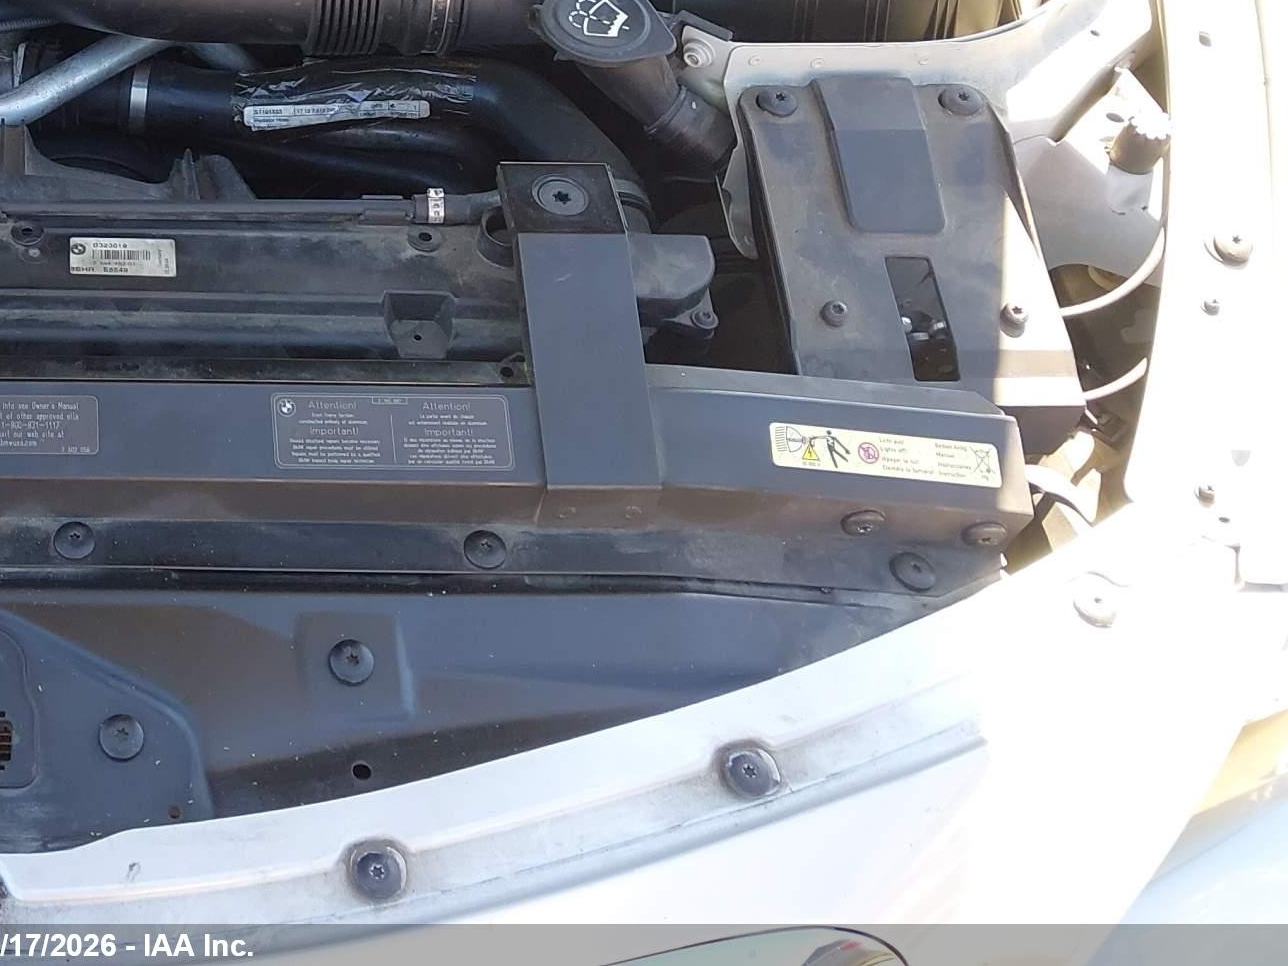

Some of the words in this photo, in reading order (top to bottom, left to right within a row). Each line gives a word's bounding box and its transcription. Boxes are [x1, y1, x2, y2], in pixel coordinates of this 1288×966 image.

[58, 402, 80, 410] Manual
[308, 401, 357, 410] Attention!
[422, 402, 471, 411] Attention!
[310, 426, 359, 436] Important!
[424, 428, 473, 436] Important!
